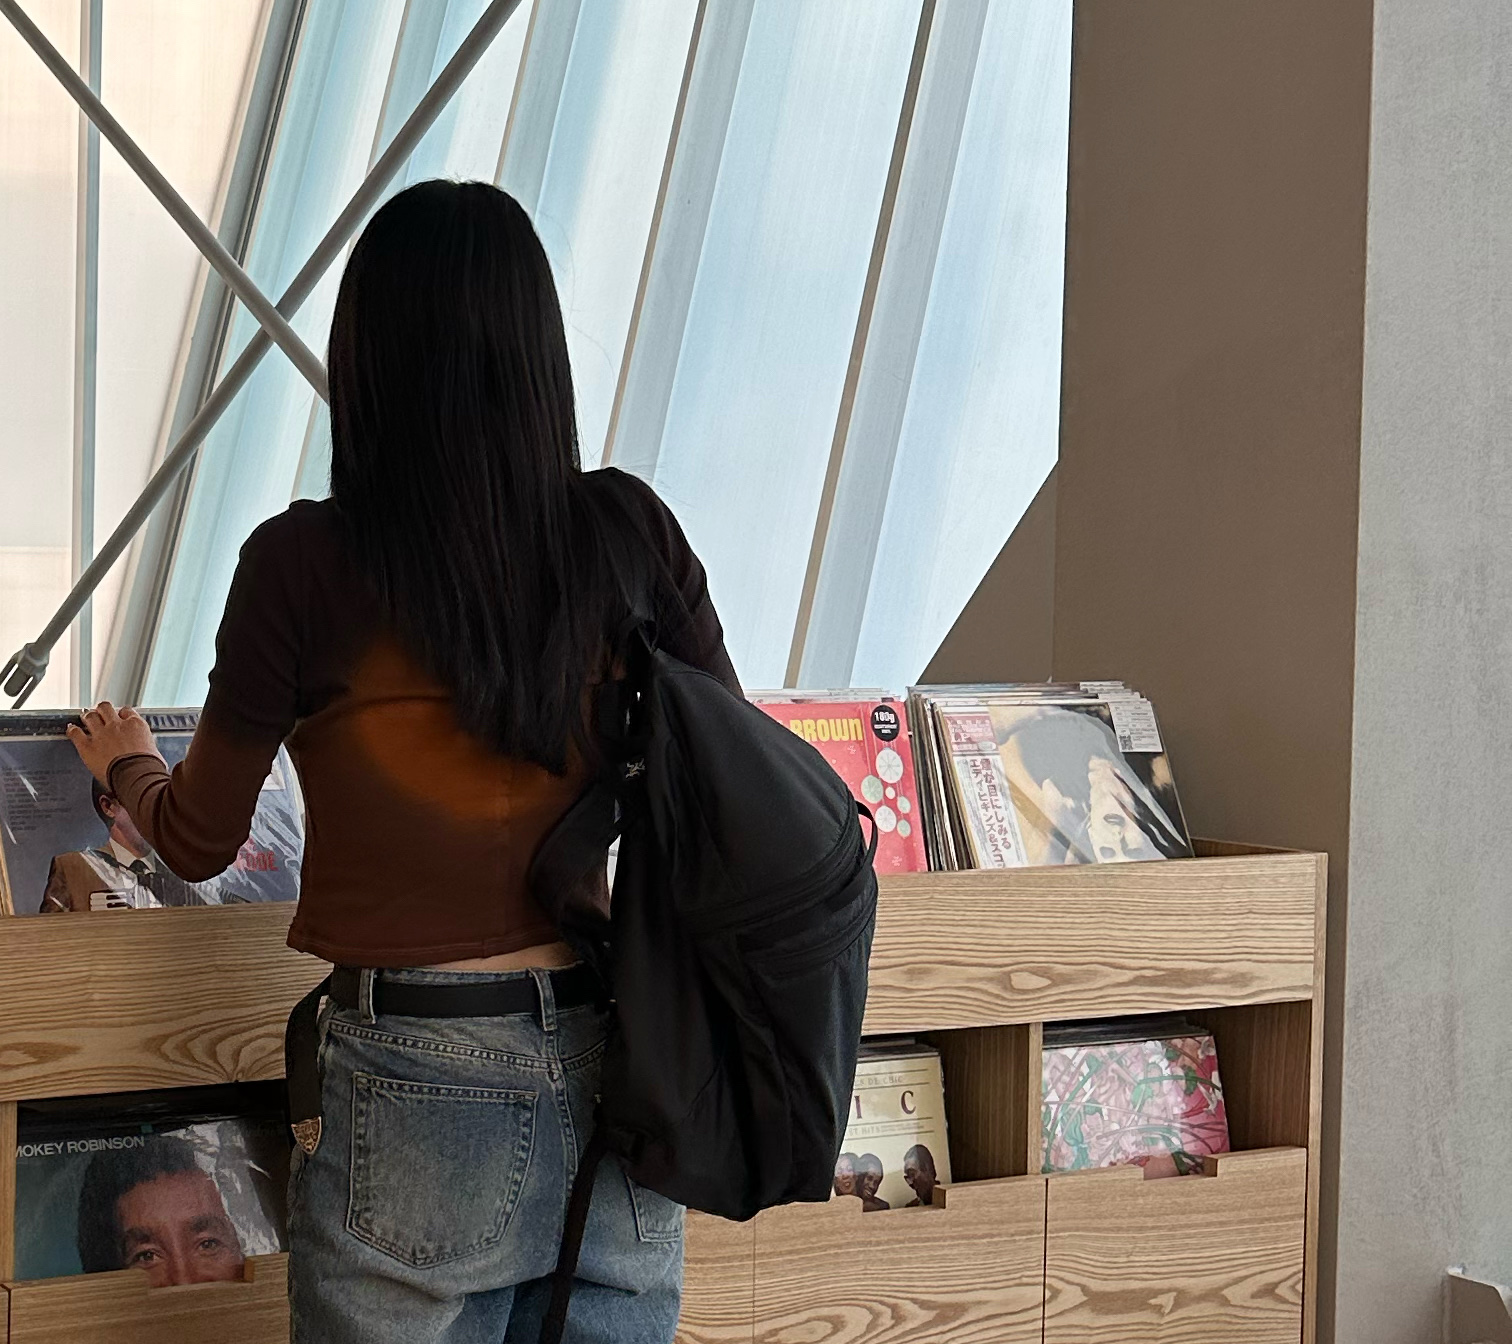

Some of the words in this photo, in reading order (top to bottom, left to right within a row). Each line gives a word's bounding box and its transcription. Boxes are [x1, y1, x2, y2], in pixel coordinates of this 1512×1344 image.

[790, 718, 864, 742] BROWN
[16, 1140, 65, 1158] MOKEY
[67, 1136, 145, 1154] ROBINSON
